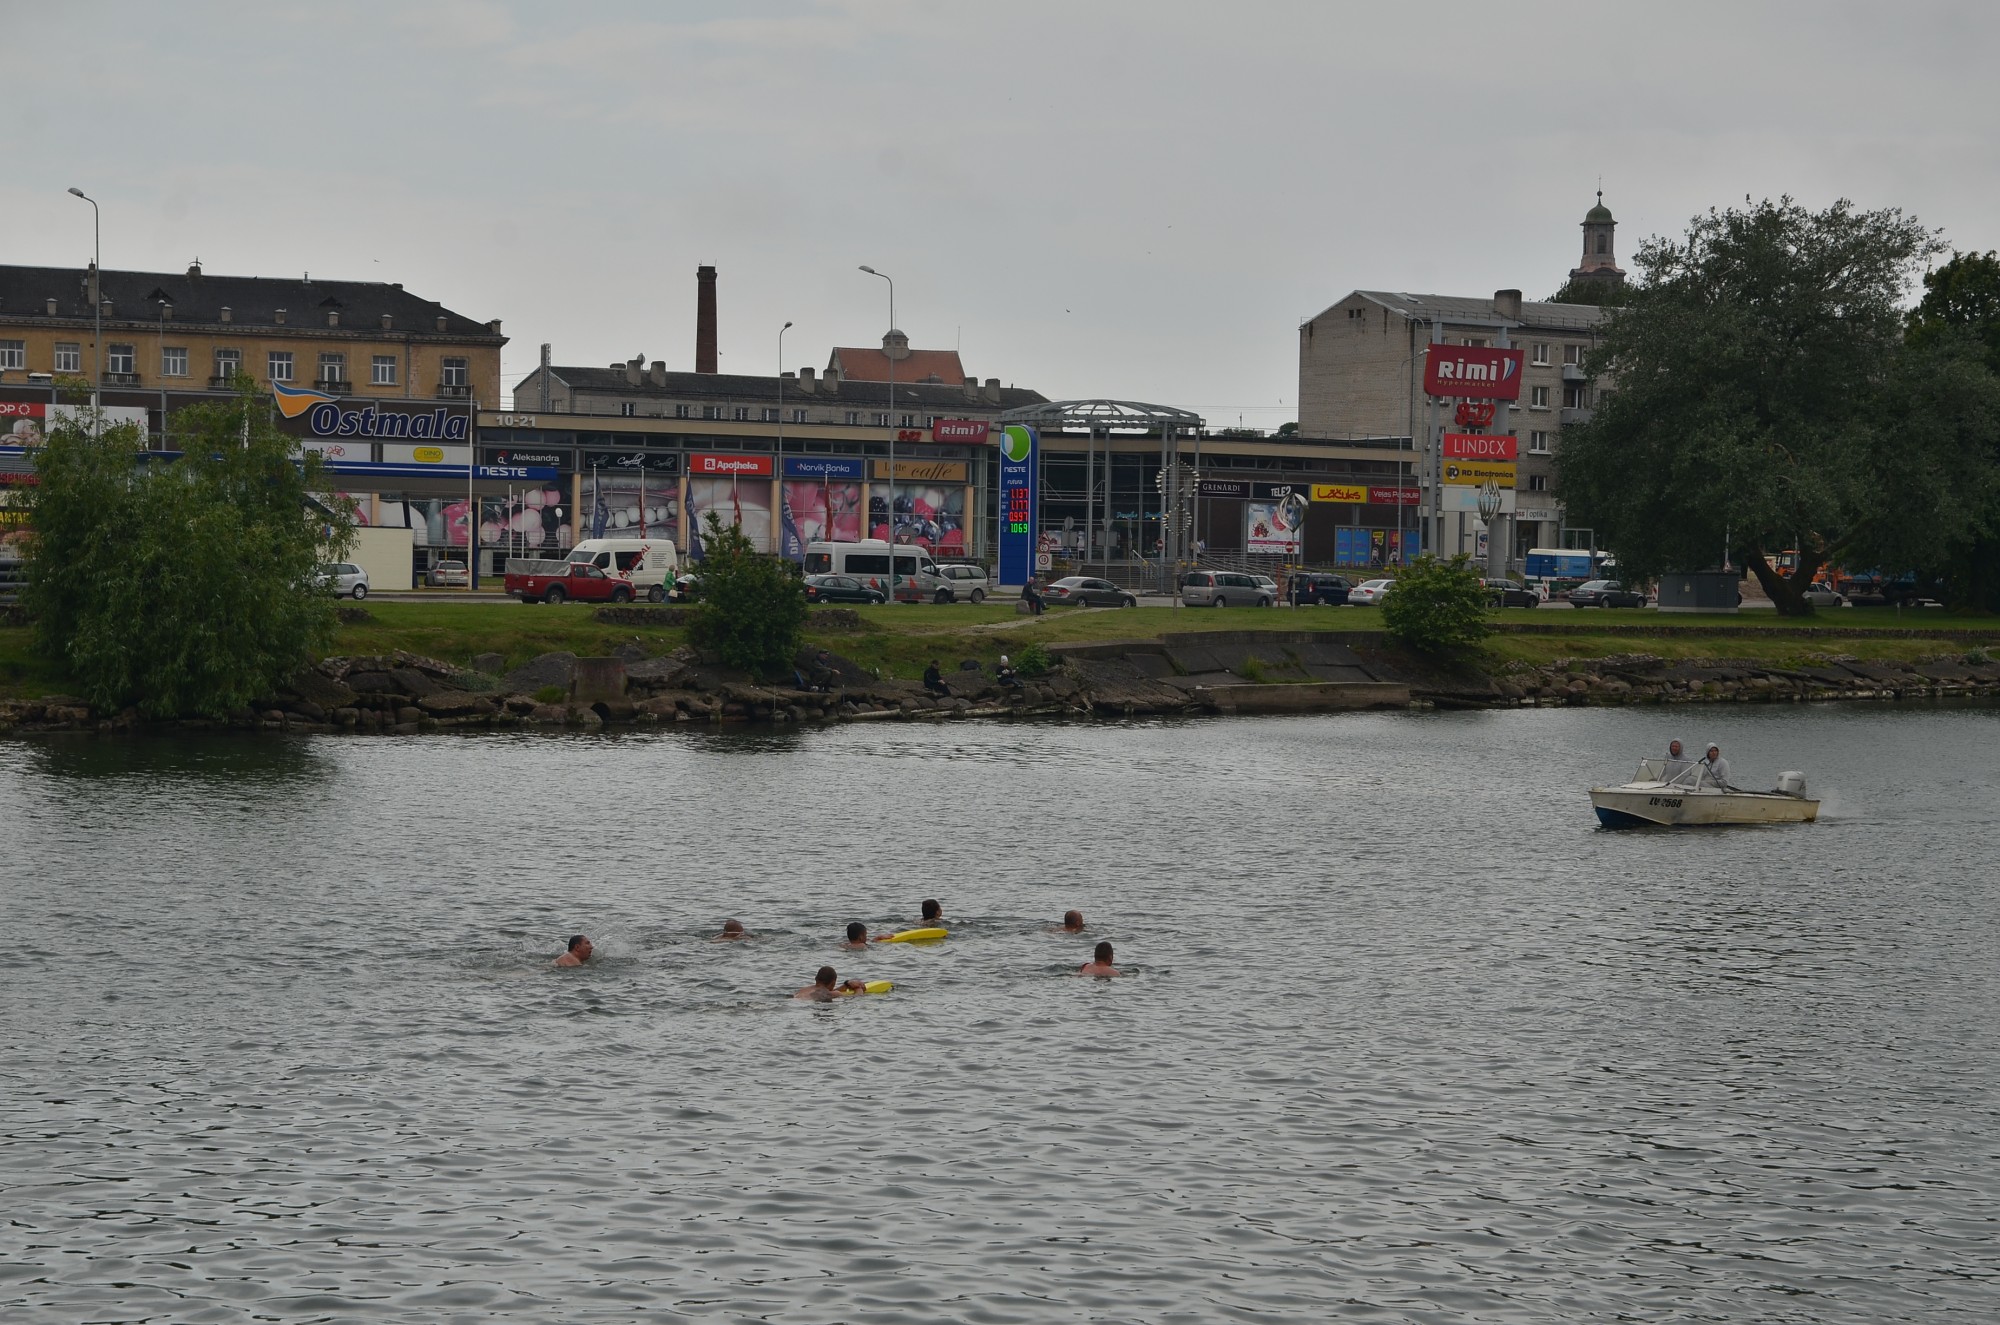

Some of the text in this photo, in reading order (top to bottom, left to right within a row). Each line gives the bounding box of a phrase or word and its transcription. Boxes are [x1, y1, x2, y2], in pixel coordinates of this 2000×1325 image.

[1437, 358, 1498, 381] Rimi
[1437, 379, 1495, 388] Hypermarket
[1455, 402, 1496, 427] 8-22
[310, 403, 469, 440] Ostmala
[496, 414, 537, 427] 10-21
[940, 424, 975, 435] Rimi
[1454, 438, 1506, 455] LINDEX
[512, 453, 560, 462] Aleksandra
[716, 460, 758, 470] Apotheka
[800, 463, 850, 473] Norvik Banka
[479, 466, 528, 477] NESTE
[1474, 469, 1514, 478] Electronics
[1202, 483, 1241, 492] GRENARDI
[1270, 485, 1292, 497] TELE2
[1529, 510, 1548, 519] optika
